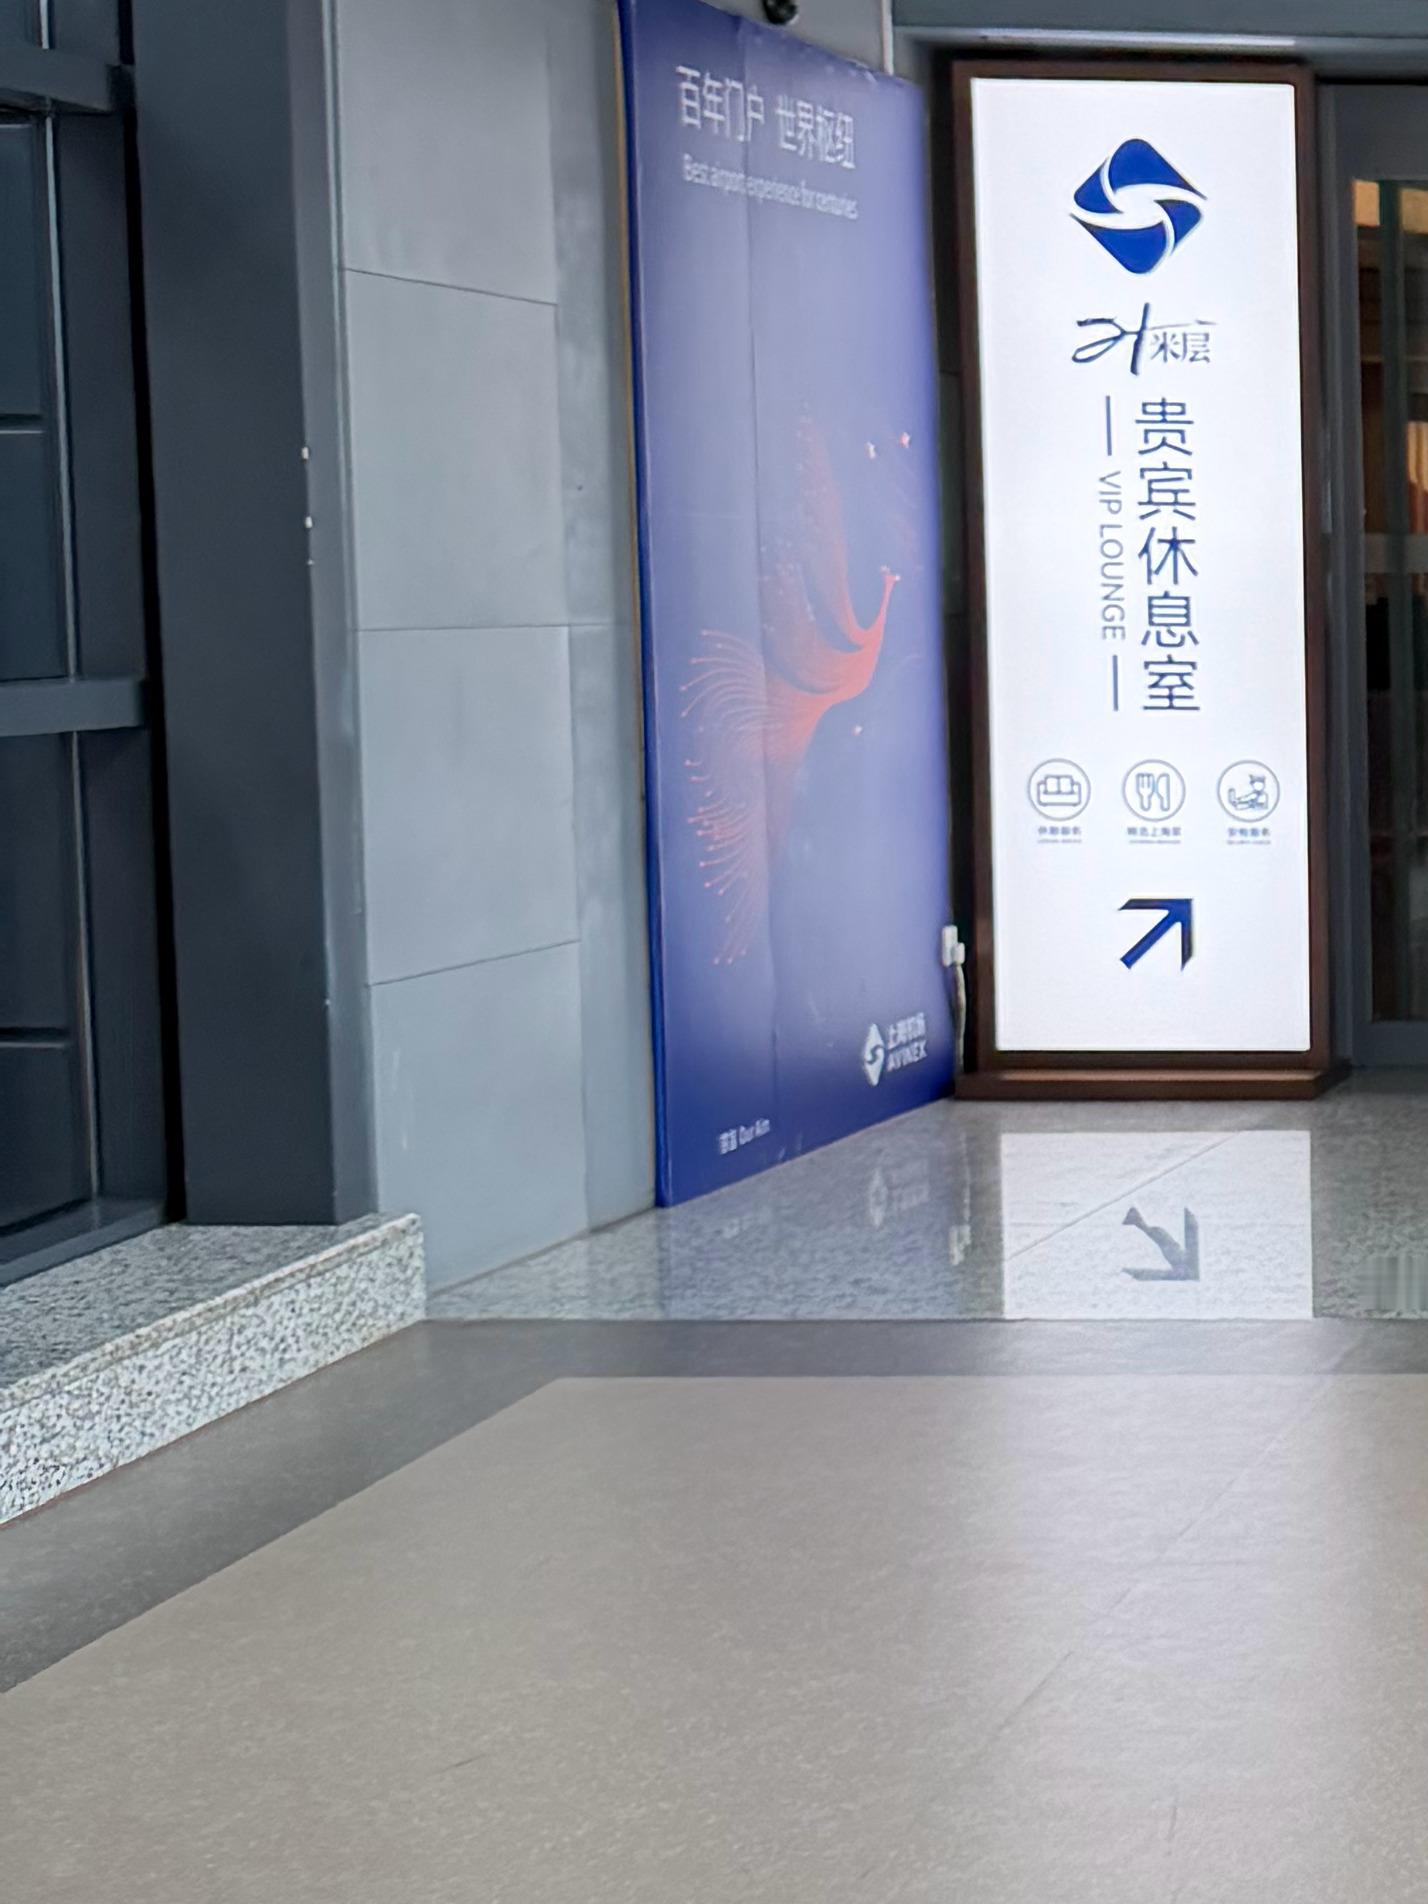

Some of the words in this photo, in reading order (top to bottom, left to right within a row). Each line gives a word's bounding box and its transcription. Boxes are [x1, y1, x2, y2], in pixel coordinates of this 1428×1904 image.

[1097, 469, 1124, 516] VIP
[1098, 522, 1127, 642] LOUNGE
[1133, 395, 1202, 713] 贵宾休息室
